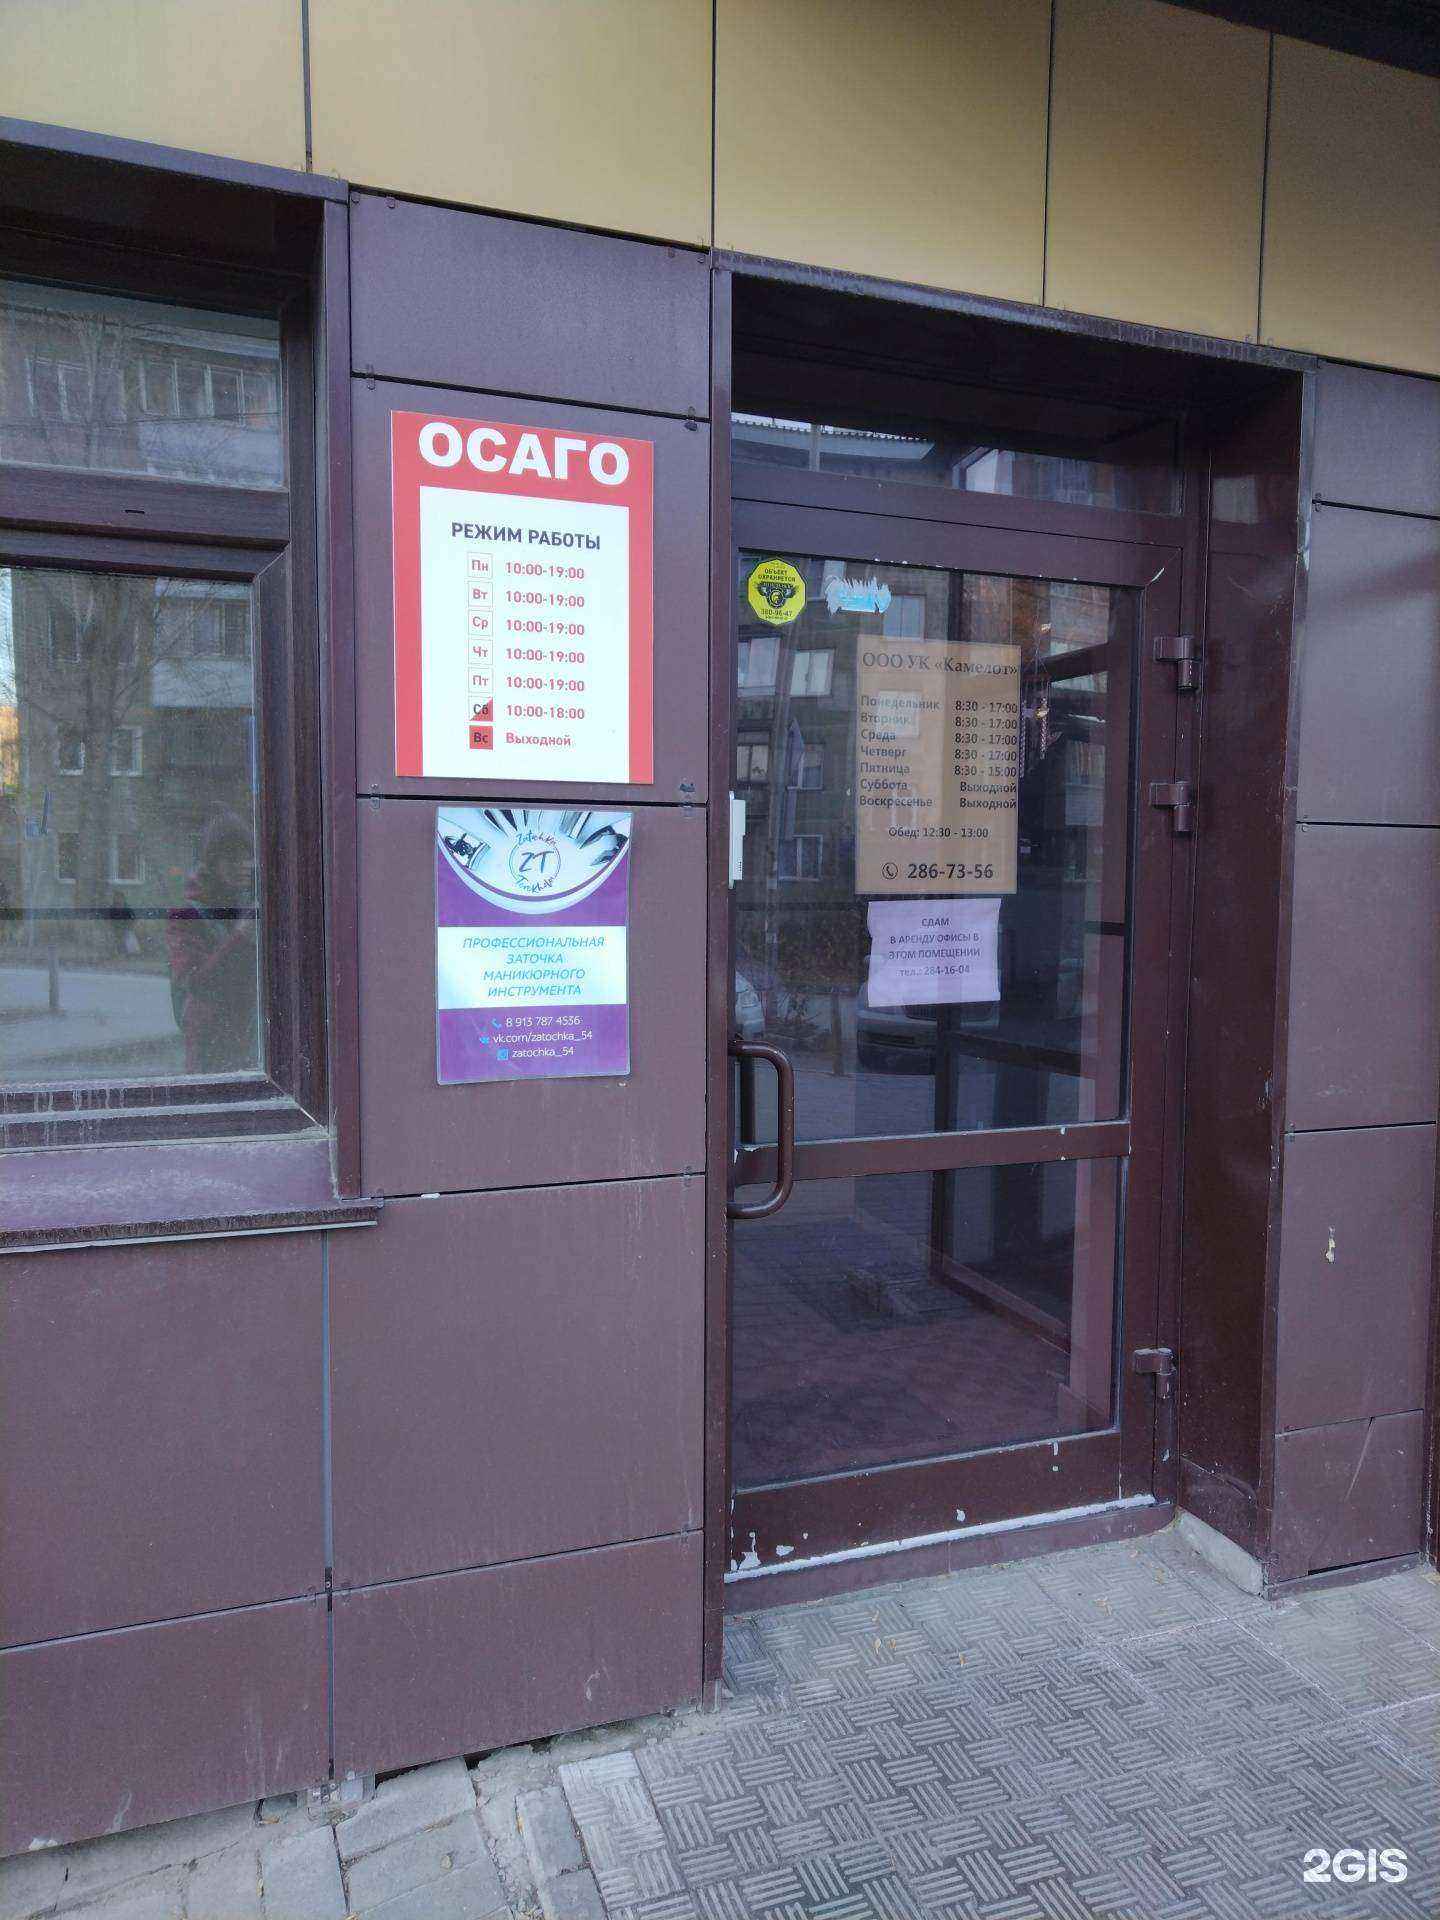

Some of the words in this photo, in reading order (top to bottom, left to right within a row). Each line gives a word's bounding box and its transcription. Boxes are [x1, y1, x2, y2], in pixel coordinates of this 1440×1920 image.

[418, 422, 630, 485] ОСАГО
[451, 522, 522, 544] РЕЖИМ
[528, 529, 601, 550] РАБОТЫ
[471, 559, 489, 572] Пн
[505, 562, 585, 579] 10:00-19:00
[472, 588, 489, 601] Вт
[505, 590, 585, 608] 10:00-19:00
[472, 616, 489, 630] Ср
[505, 619, 585, 636] 10:00-19:00
[472, 646, 489, 658] Чт
[505, 648, 585, 664] 10:00-19:00
[863, 652, 903, 669] ООО
[907, 654, 931, 670] УК
[935, 658, 1018, 676] «Камелот»
[472, 675, 489, 687] Пт
[505, 676, 585, 692] 10:00-19:00
[473, 703, 489, 716] Сб
[505, 705, 585, 720] 10:00-18:00
[861, 695, 940, 711] Понедельник
[955, 701, 978, 712] 8:30
[989, 703, 1017, 714] 17:00
[861, 713, 911, 726] Вторник
[955, 717, 978, 728] 8:30
[989, 718, 1017, 730] 17:00
[473, 732, 489, 744] Вс
[505, 732, 572, 747] Выходной
[861, 729, 896, 742] Среда
[955, 733, 978, 744] 8:30
[989, 734, 1017, 746] 17:00
[860, 745, 907, 759] Четверг
[955, 749, 977, 761] 8:30
[989, 751, 1017, 762] 17:00
[860, 762, 910, 775] Пятница
[954, 765, 977, 776] 8:30
[988, 766, 1017, 777] 15:00
[860, 778, 908, 793] Суббота
[960, 781, 1017, 794] Выходной
[859, 796, 933, 809] Воскресенье
[959, 797, 1017, 810] Выходной
[889, 827, 920, 840] Обед:
[924, 828, 950, 838] 12:30
[961, 828, 989, 838] 13:00
[907, 864, 994, 879] 286-73-56
[921, 918, 950, 928] СДАМ
[463, 936, 605, 949] ПРОФЕССИОНАЛЬНАЯ
[890, 936, 896, 944] В
[898, 935, 935, 945] АРЕНДУ
[937, 933, 971, 942] ОФИСЫ
[973, 933, 980, 942] В
[506, 953, 564, 965] ЗАТОЧКА
[888, 951, 916, 960] ЭТОМ
[918, 948, 980, 959] ПОМЕЩЕНИИ
[483, 968, 586, 981] МАНИКЮРНОГО
[924, 965, 970, 976] 284-16-04
[488, 985, 583, 997] ИНСТРУМЕНТА
[506, 1017, 513, 1028] 8
[535, 1016, 553, 1027] 787
[493, 1031, 593, 1043] vk.com/zatochka_54
[512, 1046, 574, 1058] zatochka_54
